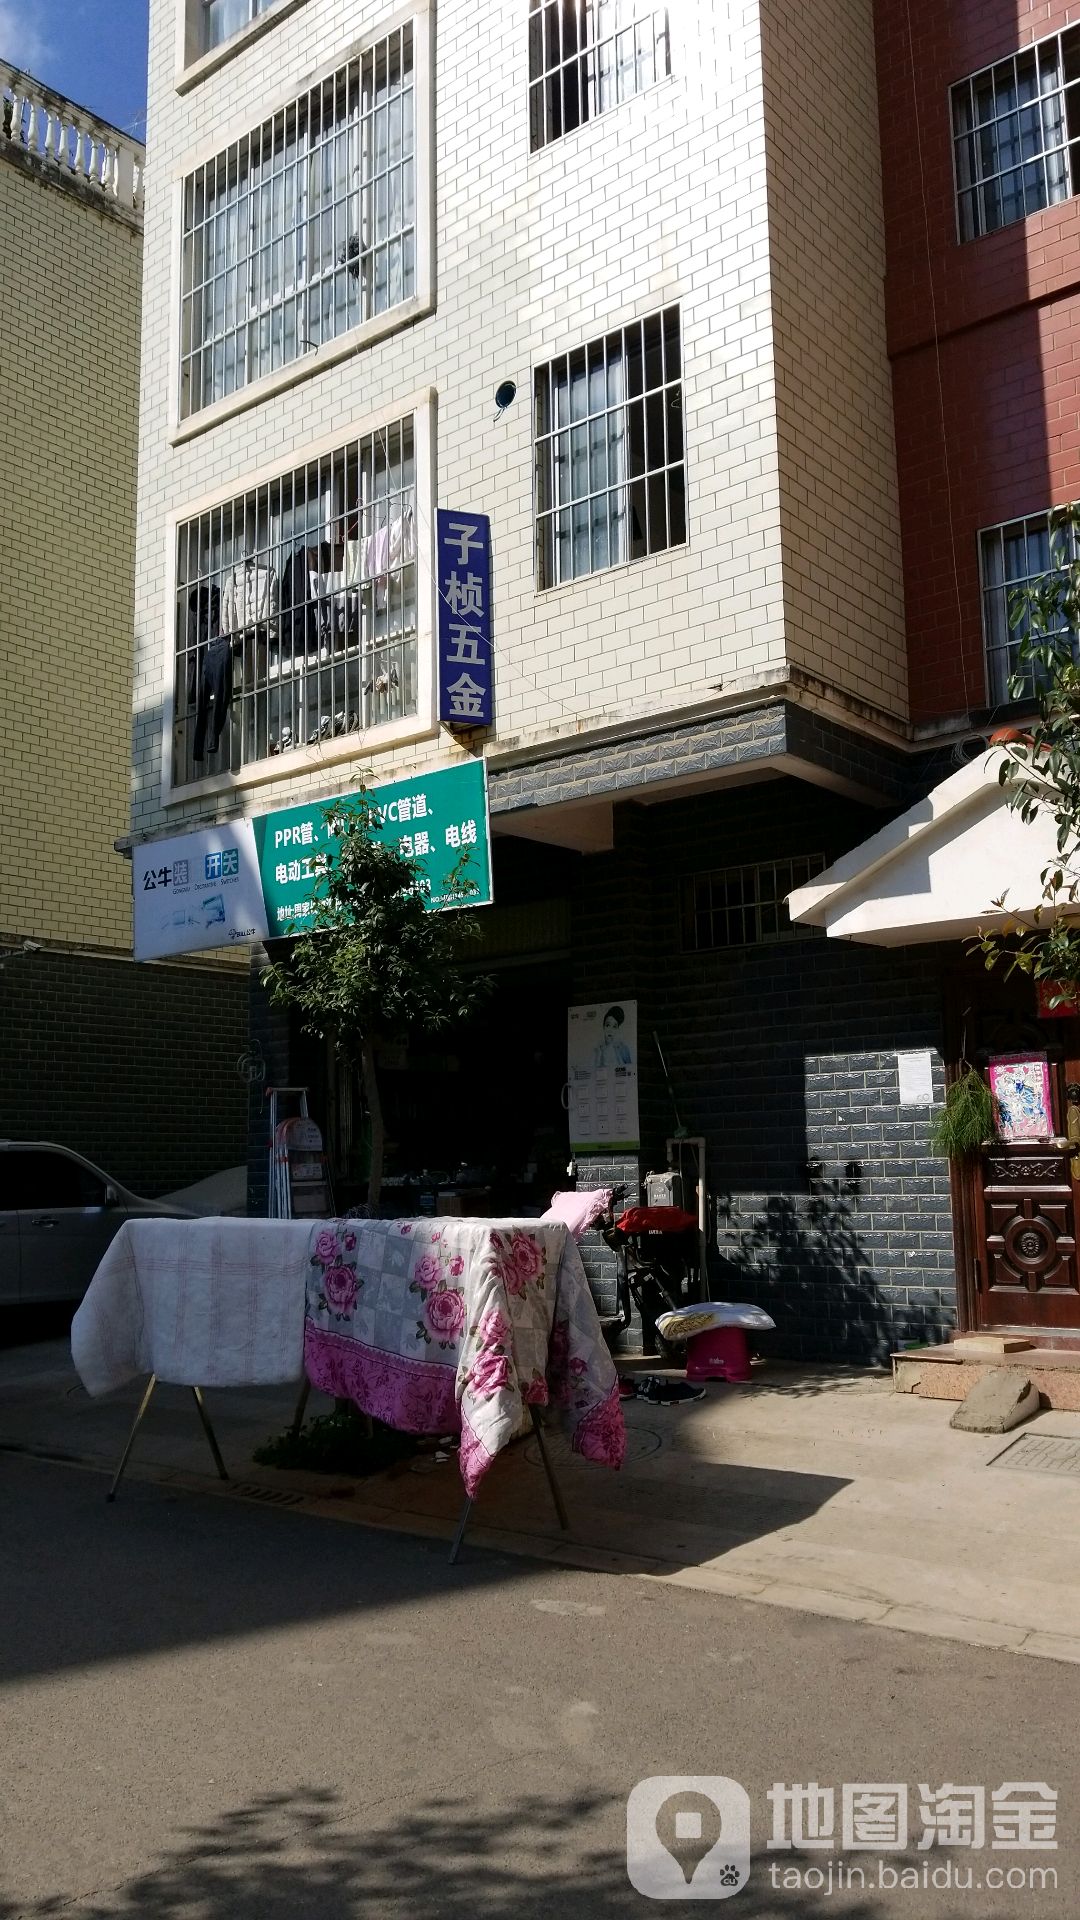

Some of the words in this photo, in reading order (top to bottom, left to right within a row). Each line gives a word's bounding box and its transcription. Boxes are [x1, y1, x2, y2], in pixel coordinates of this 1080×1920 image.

[444, 523, 486, 717] 子桢五金
[445, 819, 477, 848] 电线
